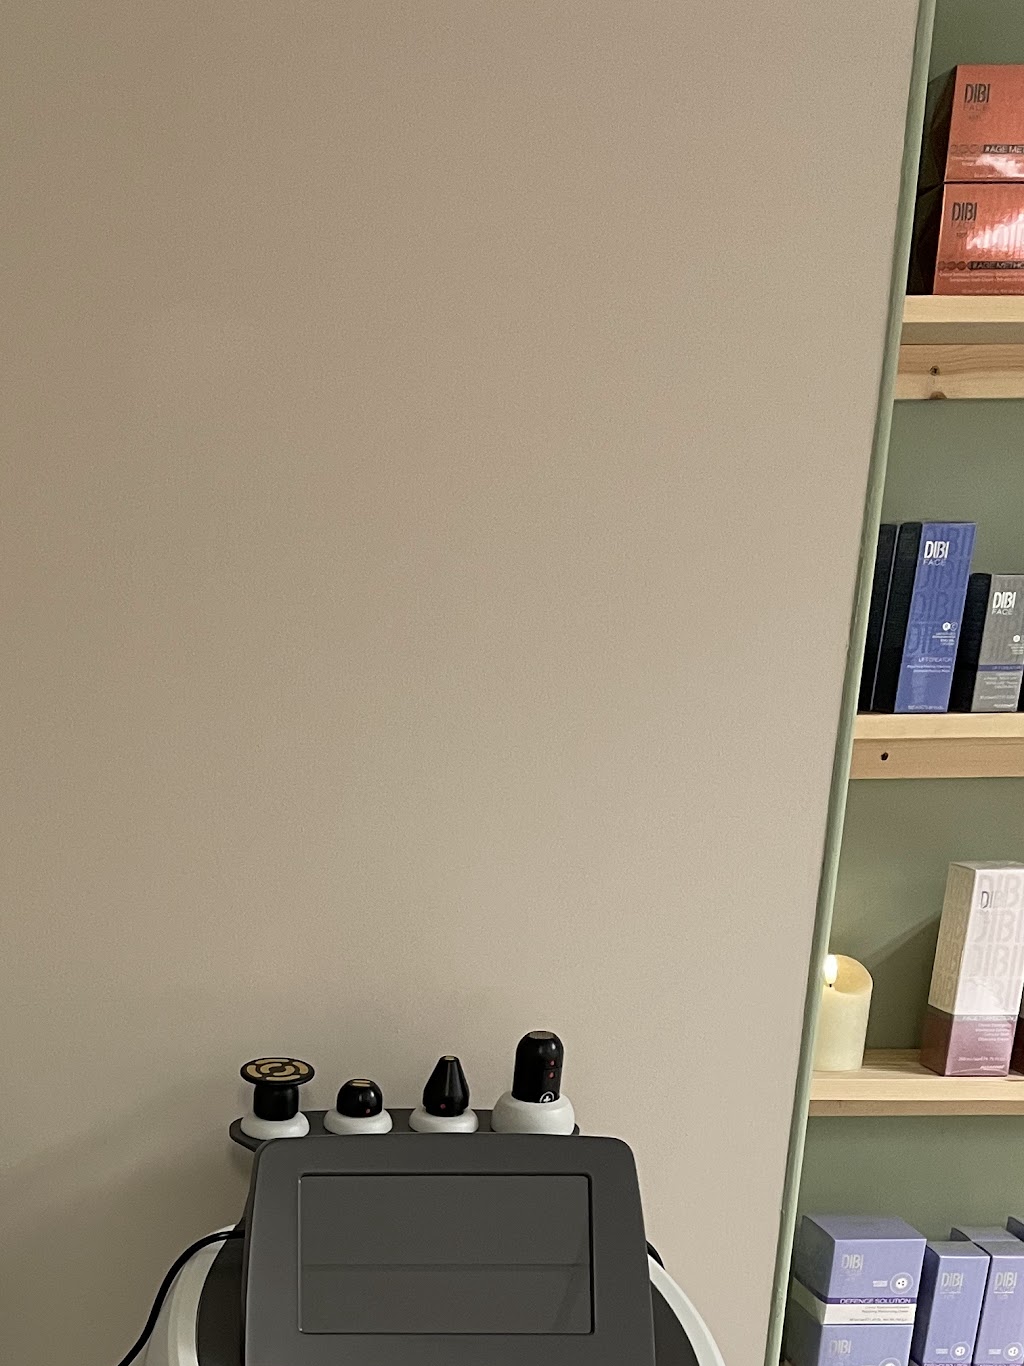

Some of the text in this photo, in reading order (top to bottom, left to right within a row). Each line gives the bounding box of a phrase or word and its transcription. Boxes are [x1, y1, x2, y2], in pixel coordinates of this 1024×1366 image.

[964, 84, 991, 103] DIBI
[951, 202, 978, 221] DIBI
[923, 541, 950, 559] DIBI
[922, 559, 947, 567] FACE
[992, 592, 1017, 609] DIBI
[841, 1254, 864, 1271] DIBI
[940, 1272, 964, 1288] DIBI
[994, 1271, 1018, 1288] DIBI
